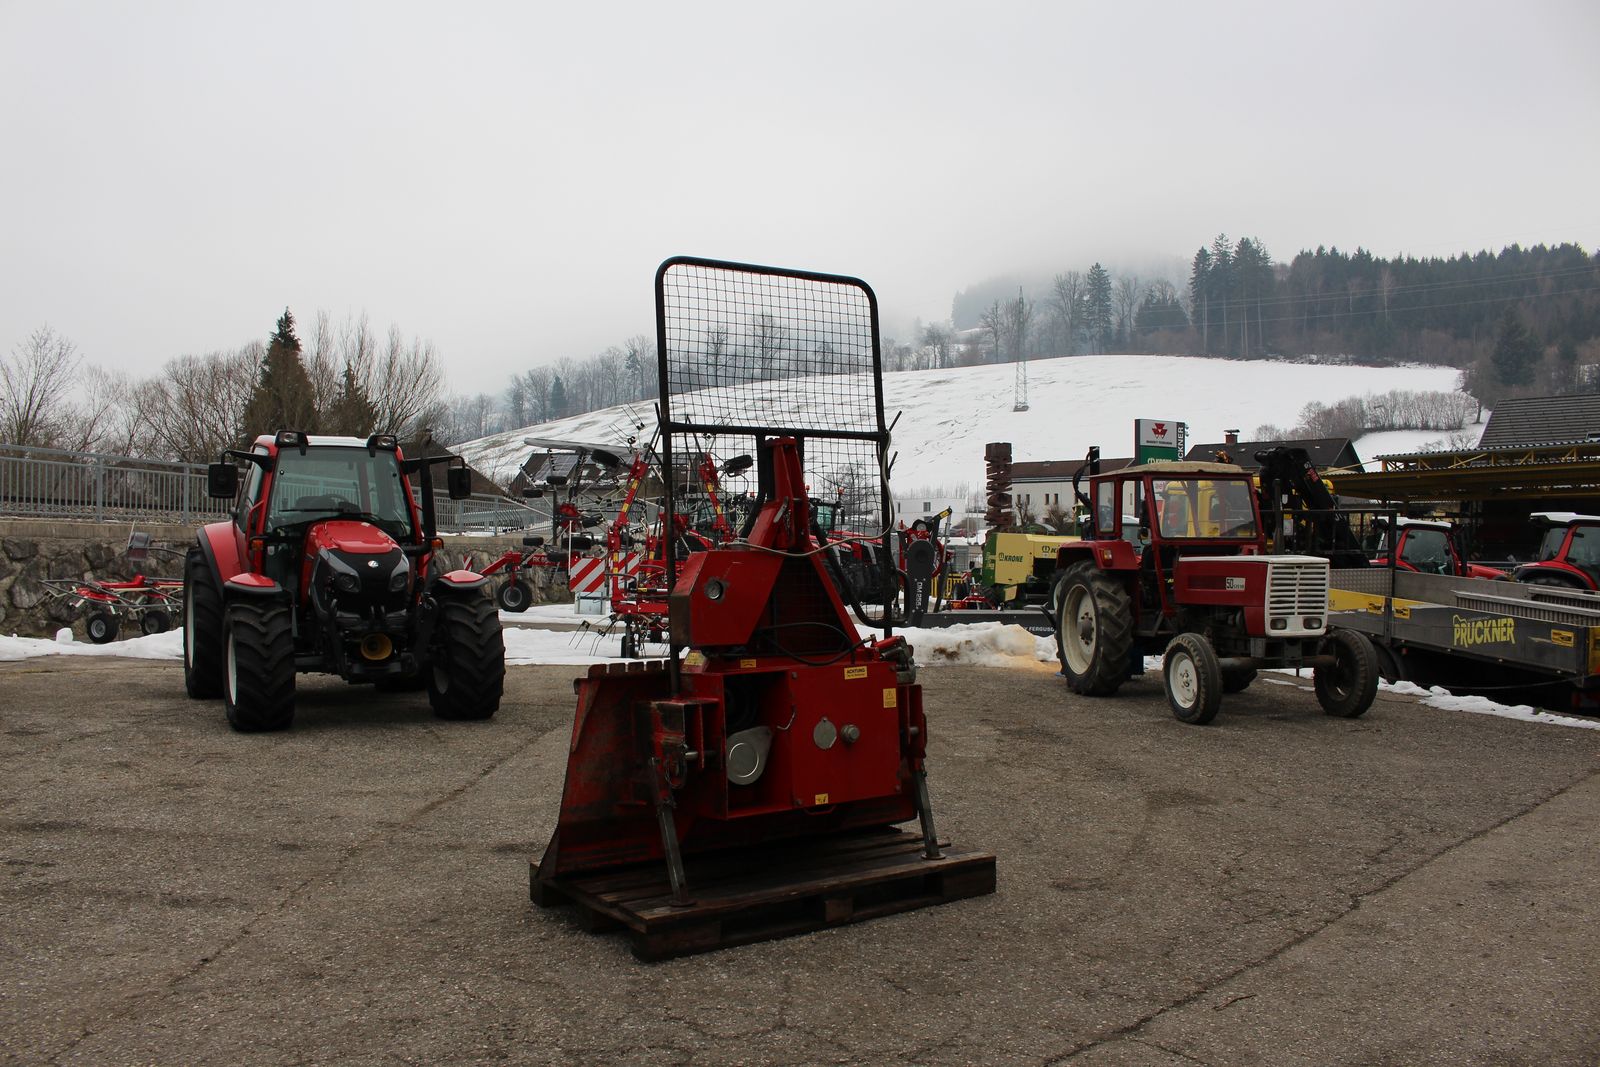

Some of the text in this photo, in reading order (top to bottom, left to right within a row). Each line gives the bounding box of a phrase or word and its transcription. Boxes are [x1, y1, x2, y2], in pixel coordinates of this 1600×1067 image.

[916, 581, 922, 592] DM
[1226, 578, 1234, 589] 50
[1453, 614, 1516, 648] PRUCKNER
